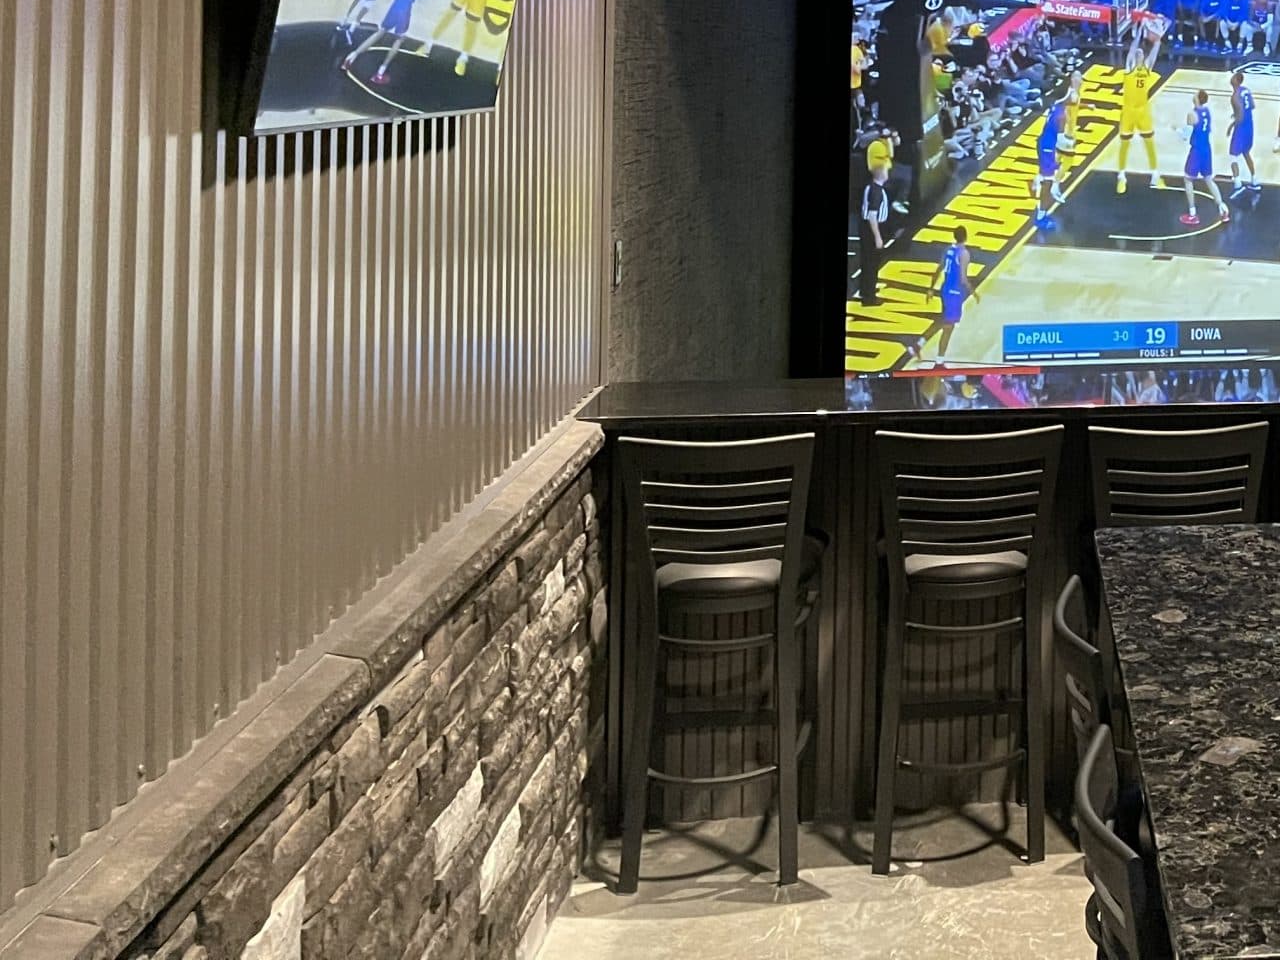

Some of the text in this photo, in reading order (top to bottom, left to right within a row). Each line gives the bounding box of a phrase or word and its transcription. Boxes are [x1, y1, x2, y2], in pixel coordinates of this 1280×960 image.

[1017, 331, 1064, 345] DePAUL
[1113, 330, 1129, 342] 3-0
[1146, 327, 1166, 345] 19
[1190, 328, 1222, 341] IOWA
[1139, 348, 1168, 358] FOULS:
